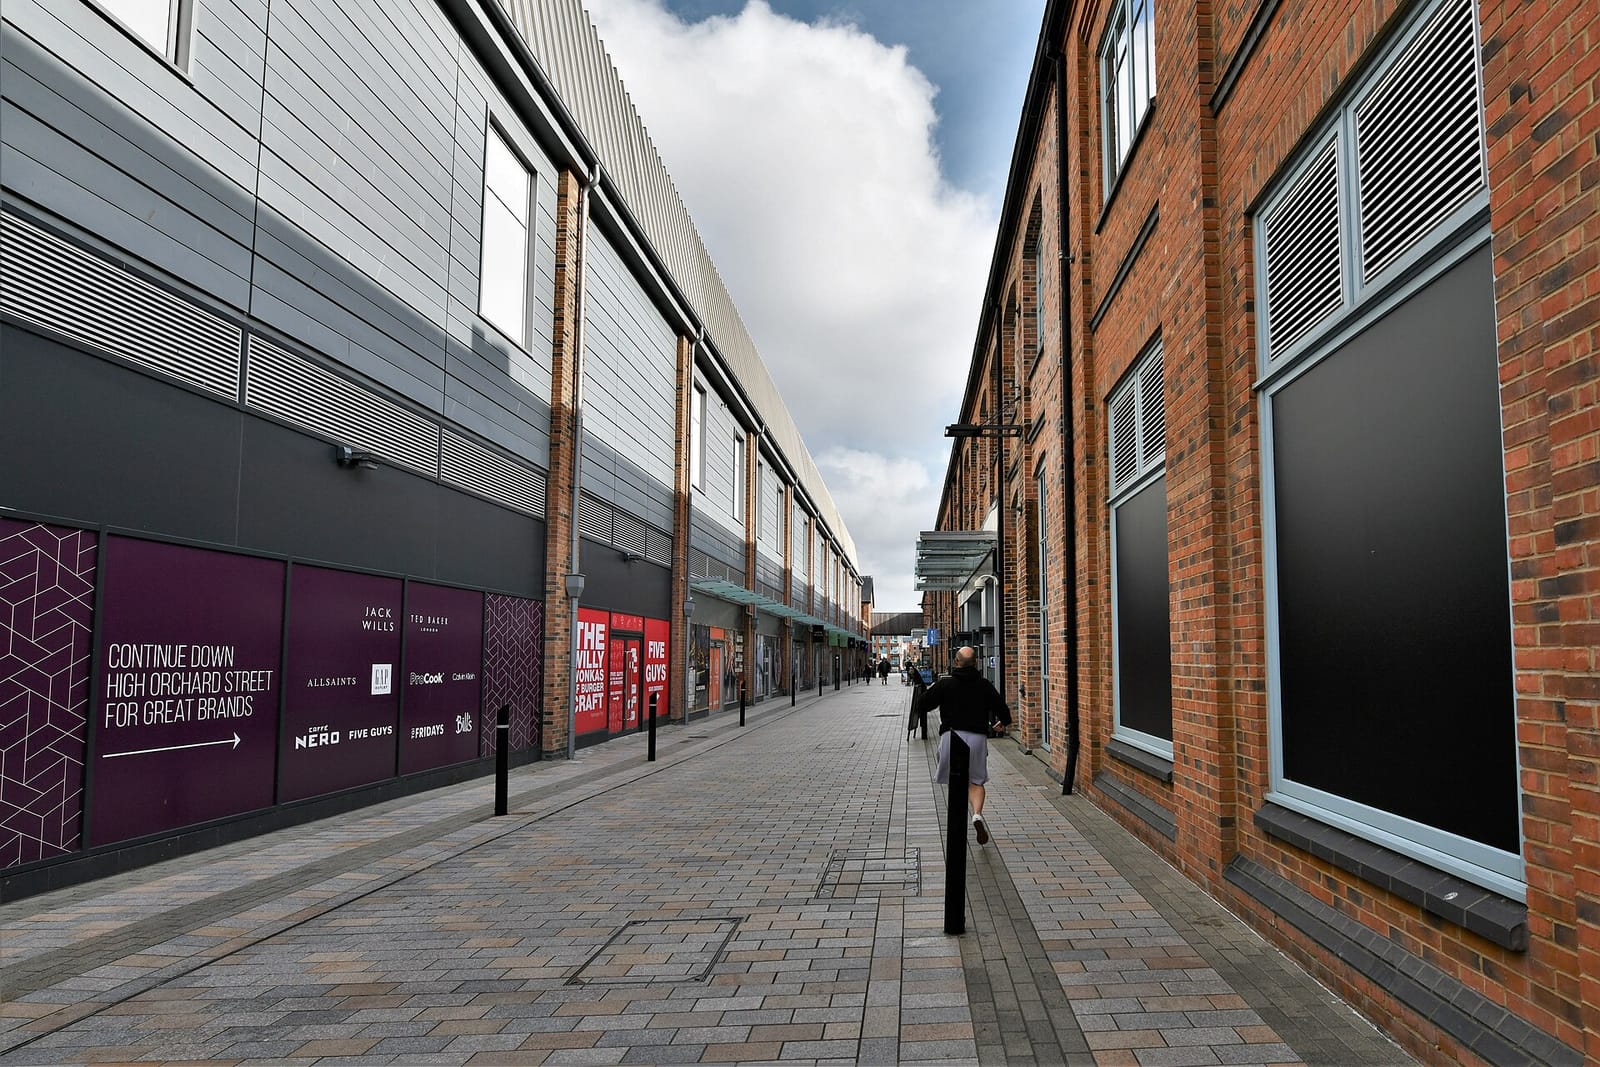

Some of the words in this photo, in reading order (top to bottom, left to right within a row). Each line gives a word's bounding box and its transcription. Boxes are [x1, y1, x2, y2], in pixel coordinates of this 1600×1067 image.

[366, 606, 391, 618] JACK
[411, 615, 424, 624] TED
[428, 616, 448, 625] BAKER
[362, 620, 394, 632] WILLS
[577, 621, 605, 650] THE
[109, 643, 187, 669] CONTINUE
[191, 645, 234, 668] DOWN
[648, 641, 665, 659] FIVE
[410, 671, 444, 685] ProCook
[645, 663, 666, 682] GUYS
[107, 673, 146, 698] HIGH
[150, 671, 221, 696] ORCHARD
[224, 670, 274, 693] STREET
[307, 677, 357, 688] ALLSAINTS
[581, 682, 604, 694] BURGER
[106, 702, 138, 729] FOR
[143, 698, 195, 725] GREAT
[198, 695, 254, 721] BRANDS
[415, 723, 444, 739] FRIDAYS
[455, 711, 473, 734] Bill's
[295, 731, 340, 750] NERO
[348, 728, 368, 740] FIVE
[370, 725, 393, 737] GUYS
